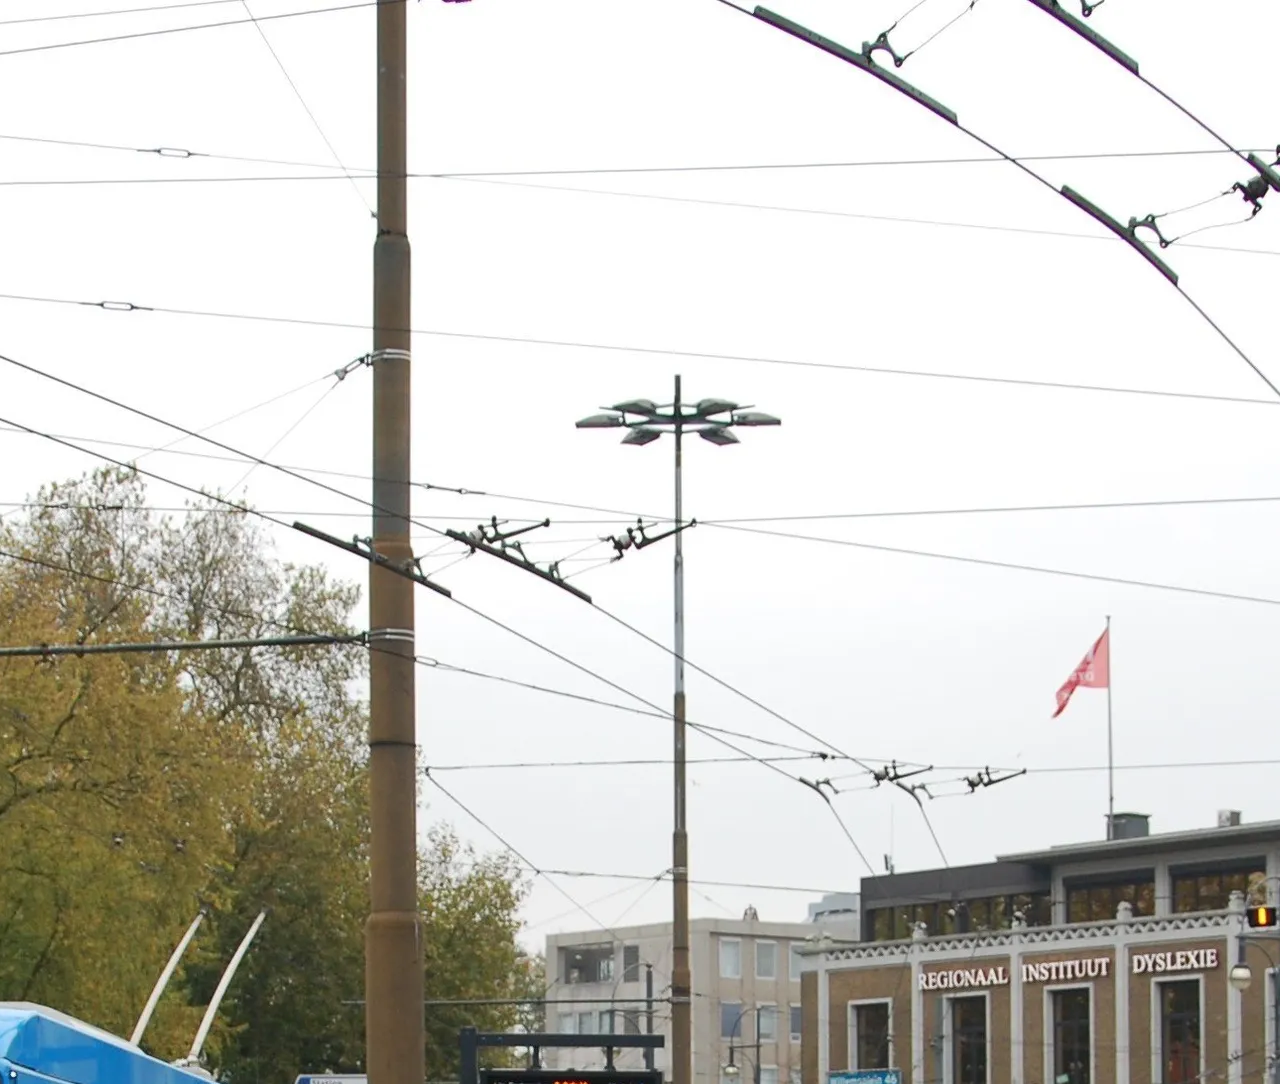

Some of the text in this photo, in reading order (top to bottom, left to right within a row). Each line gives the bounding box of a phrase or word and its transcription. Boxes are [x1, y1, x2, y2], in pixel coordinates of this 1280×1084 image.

[918, 948, 1218, 990] REGIONAAL INSTITUUT DYSLEXIE
